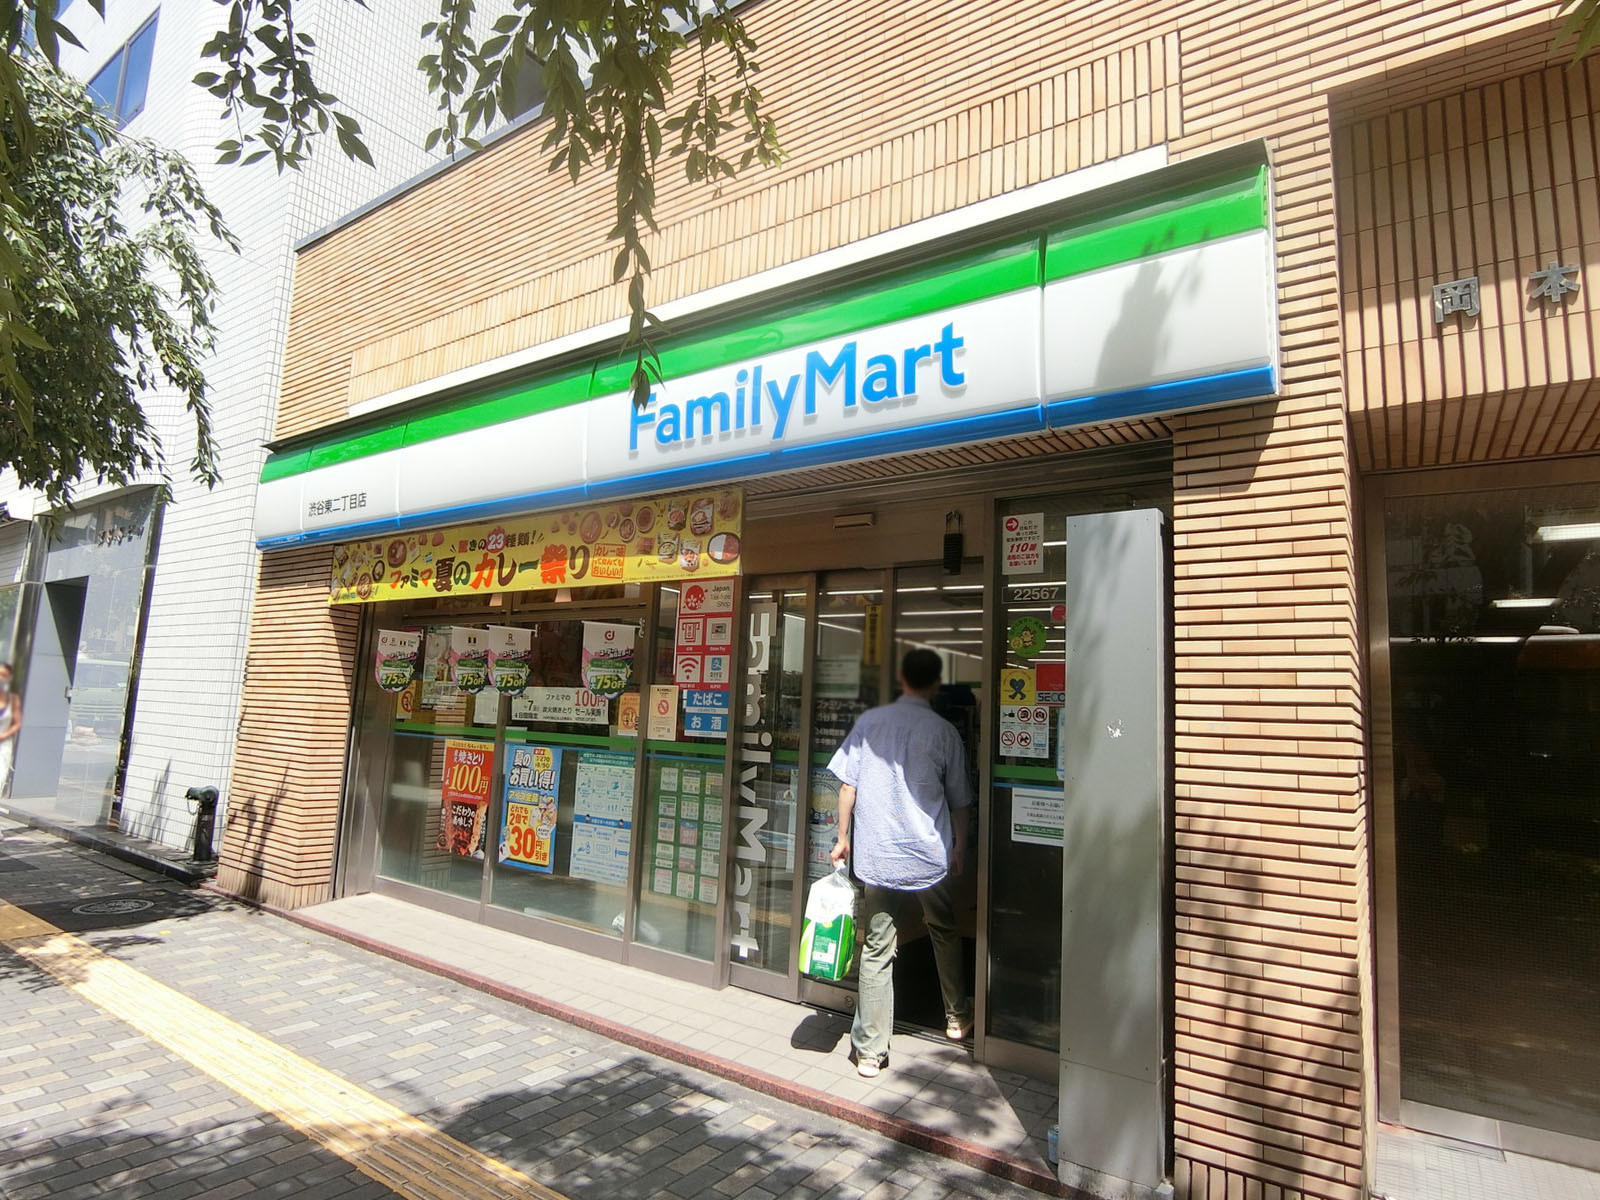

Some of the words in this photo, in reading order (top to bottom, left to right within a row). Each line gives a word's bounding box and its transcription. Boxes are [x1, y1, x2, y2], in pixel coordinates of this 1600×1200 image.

[629, 323, 966, 452] FamilyMart
[308, 492, 368, 517] 渋谷東二丁目店
[1014, 587, 1059, 600] 22567
[692, 692, 723, 706] たばこ
[509, 768, 555, 790] お買い得!
